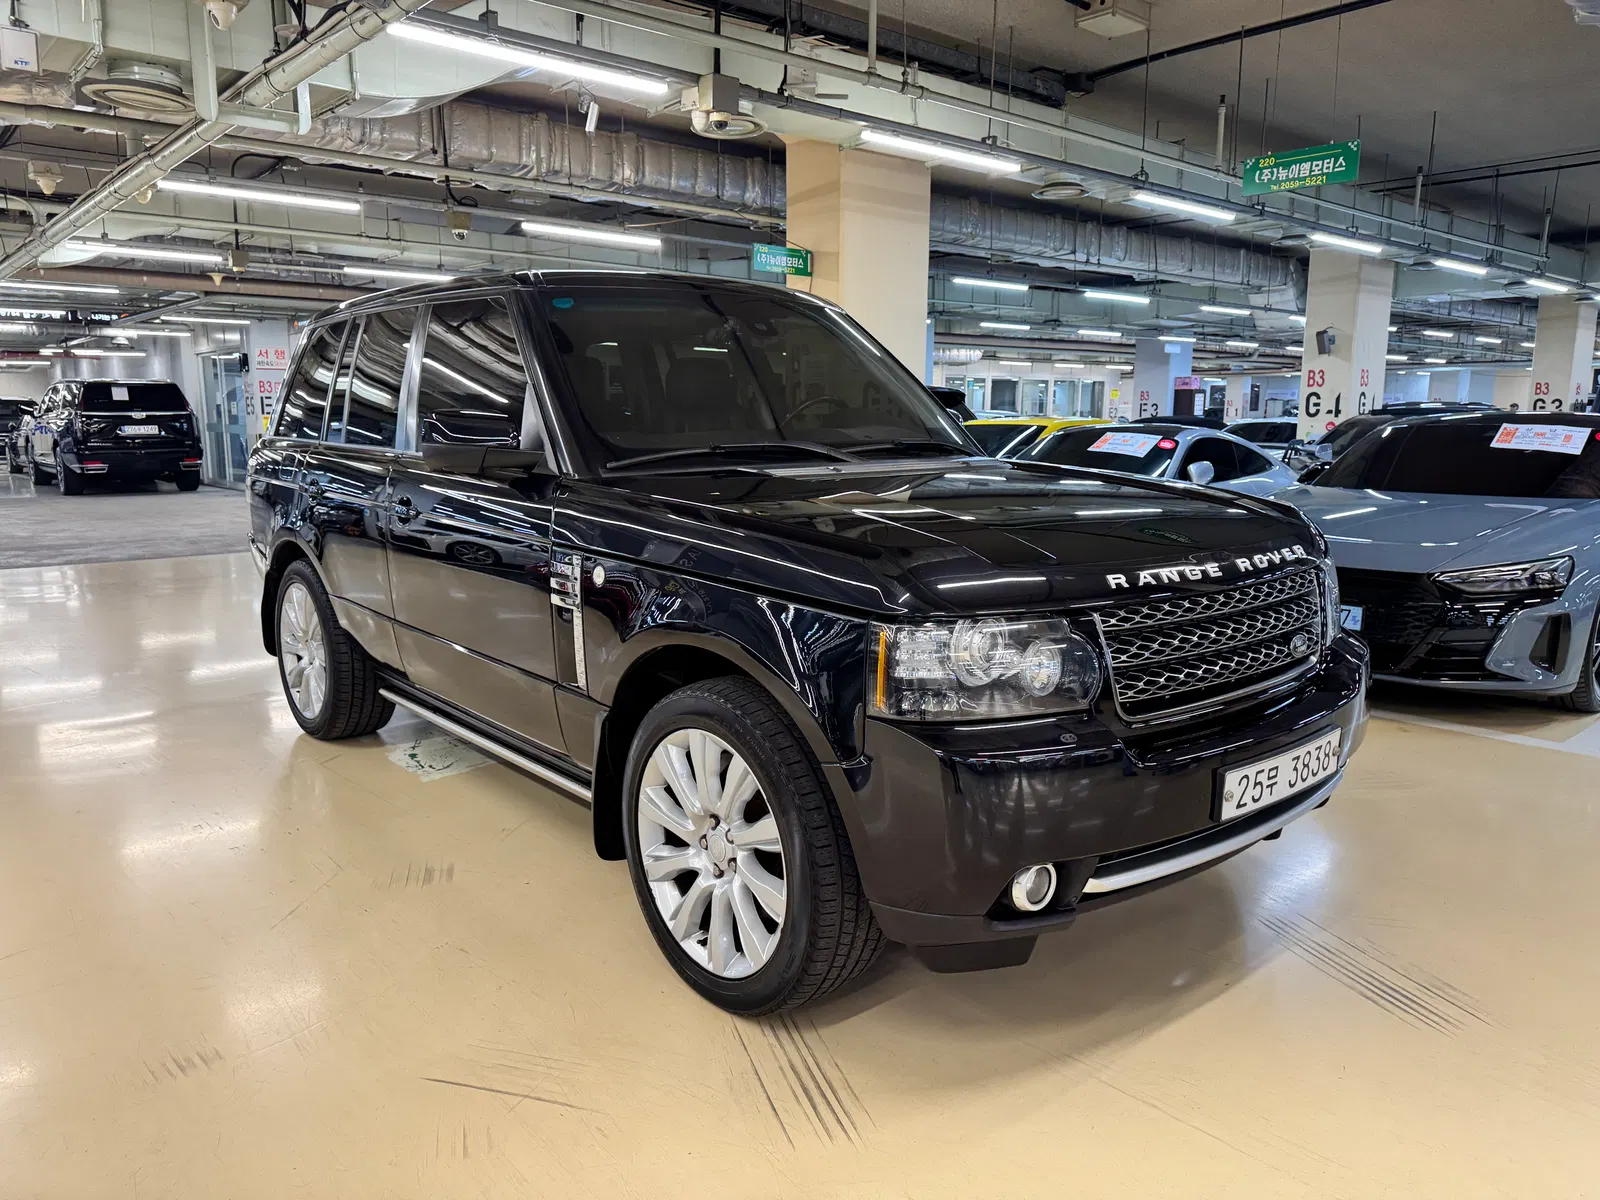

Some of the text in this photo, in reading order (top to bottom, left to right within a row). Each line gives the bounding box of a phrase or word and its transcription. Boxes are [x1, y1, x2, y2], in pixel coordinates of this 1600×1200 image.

[1255, 156, 1345, 182] (주)뉴이엠모터스
[1259, 157, 1275, 168] 220
[1281, 176, 1326, 189] 2059-5221
[1307, 369, 1325, 388] B3
[1360, 368, 1369, 387] B3
[259, 381, 273, 393] B3
[1534, 382, 1550, 396] B3
[1140, 391, 1150, 401] B3
[1106, 544, 1308, 589] RANGE ROVER
[1235, 740, 1331, 809] 25무 3838
